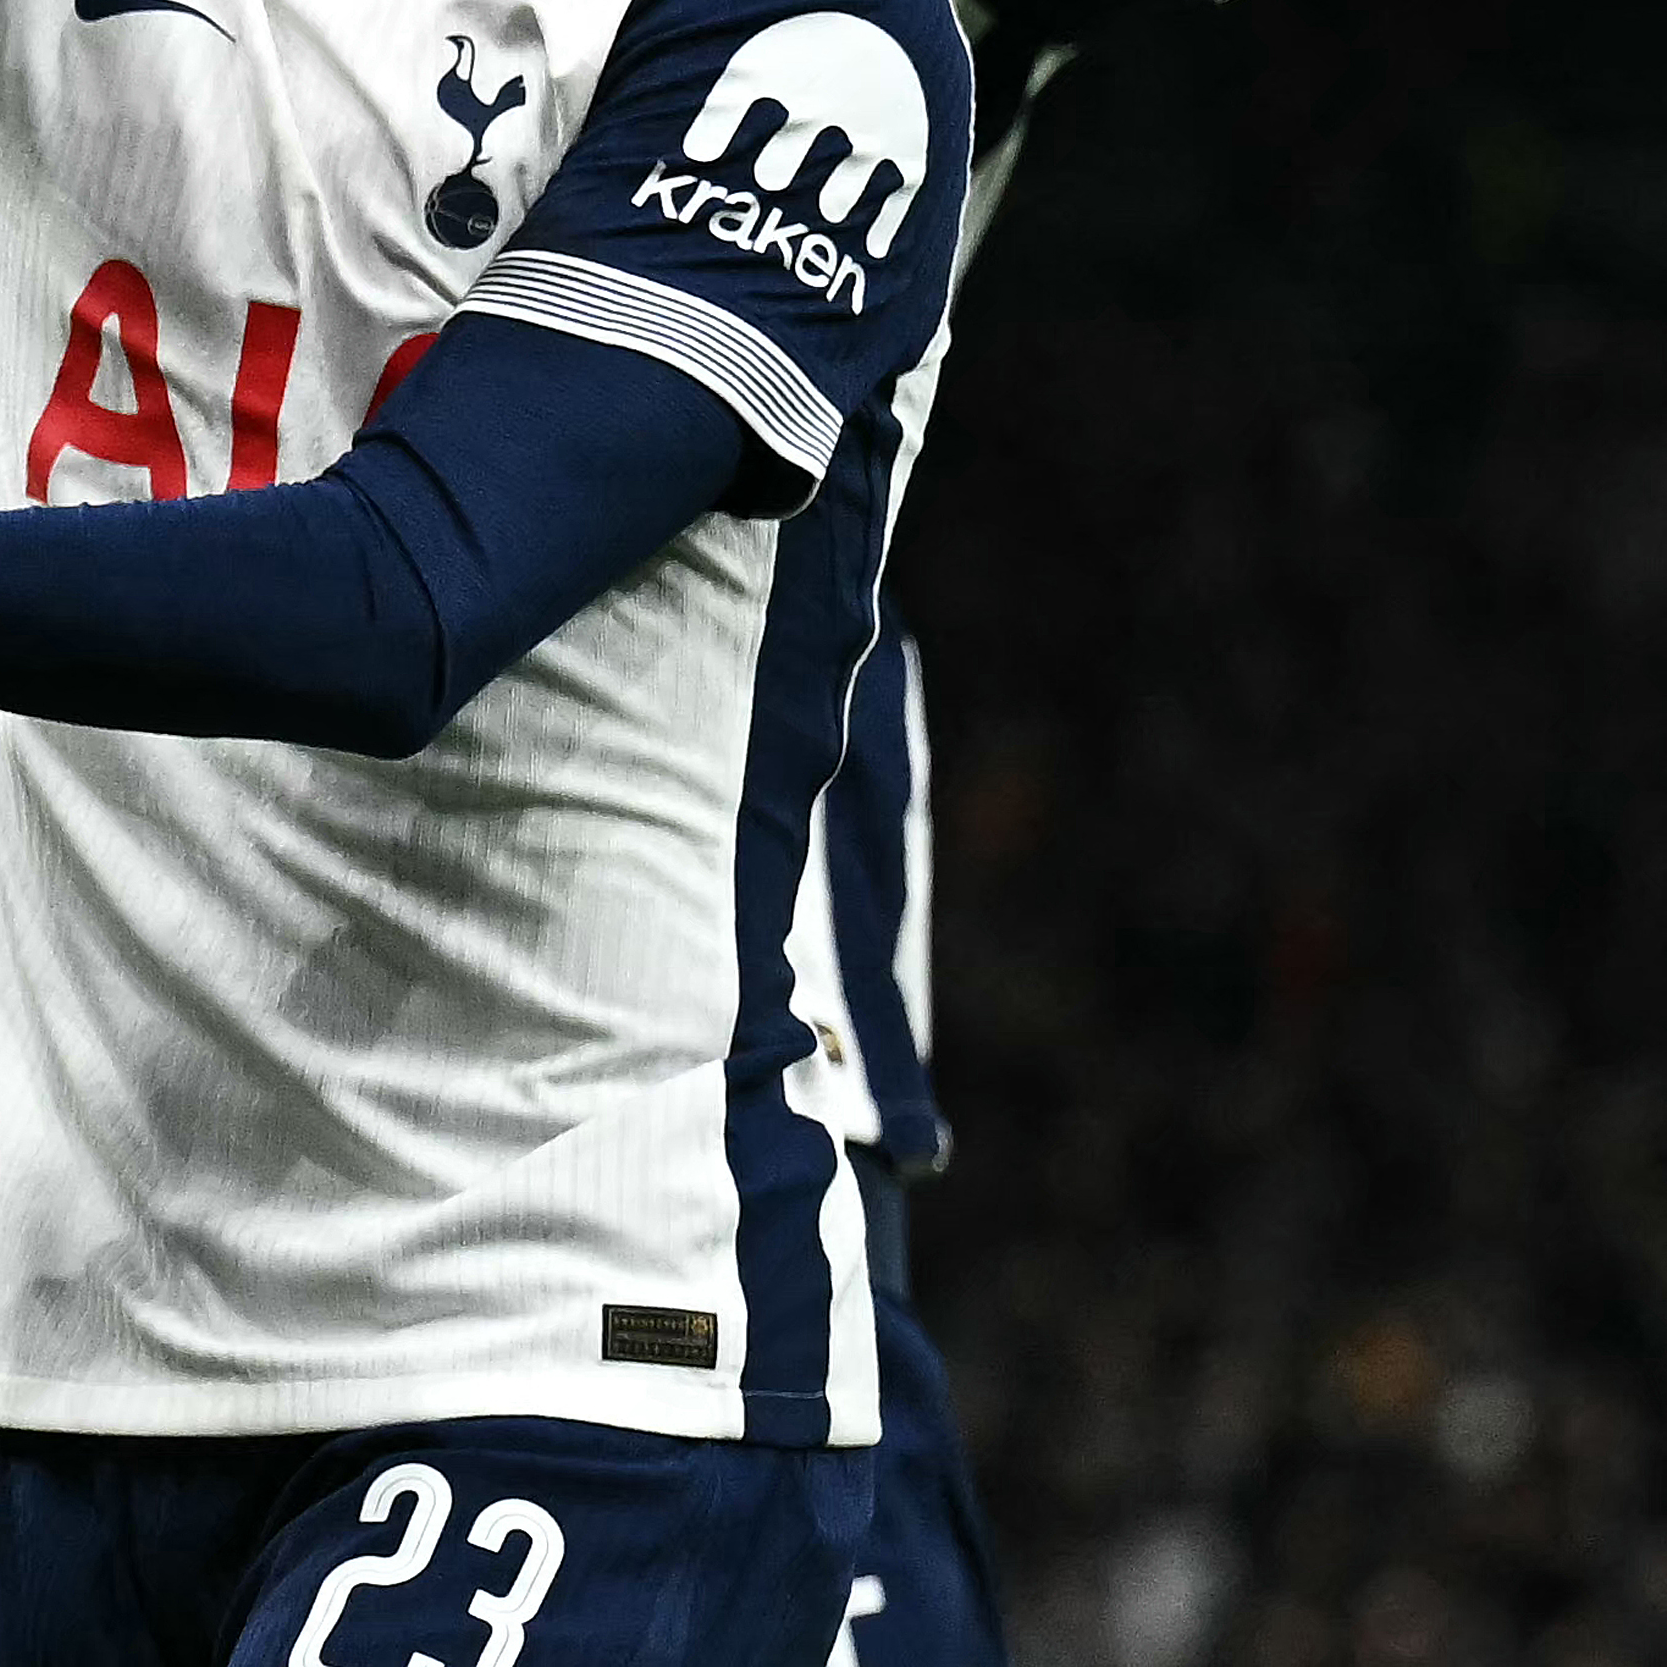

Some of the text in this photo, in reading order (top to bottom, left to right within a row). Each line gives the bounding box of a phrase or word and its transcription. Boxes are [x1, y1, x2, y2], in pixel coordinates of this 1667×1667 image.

[630, 159, 867, 316] kraken
[25, 258, 440, 502] AI
[288, 1462, 565, 1667] 23
